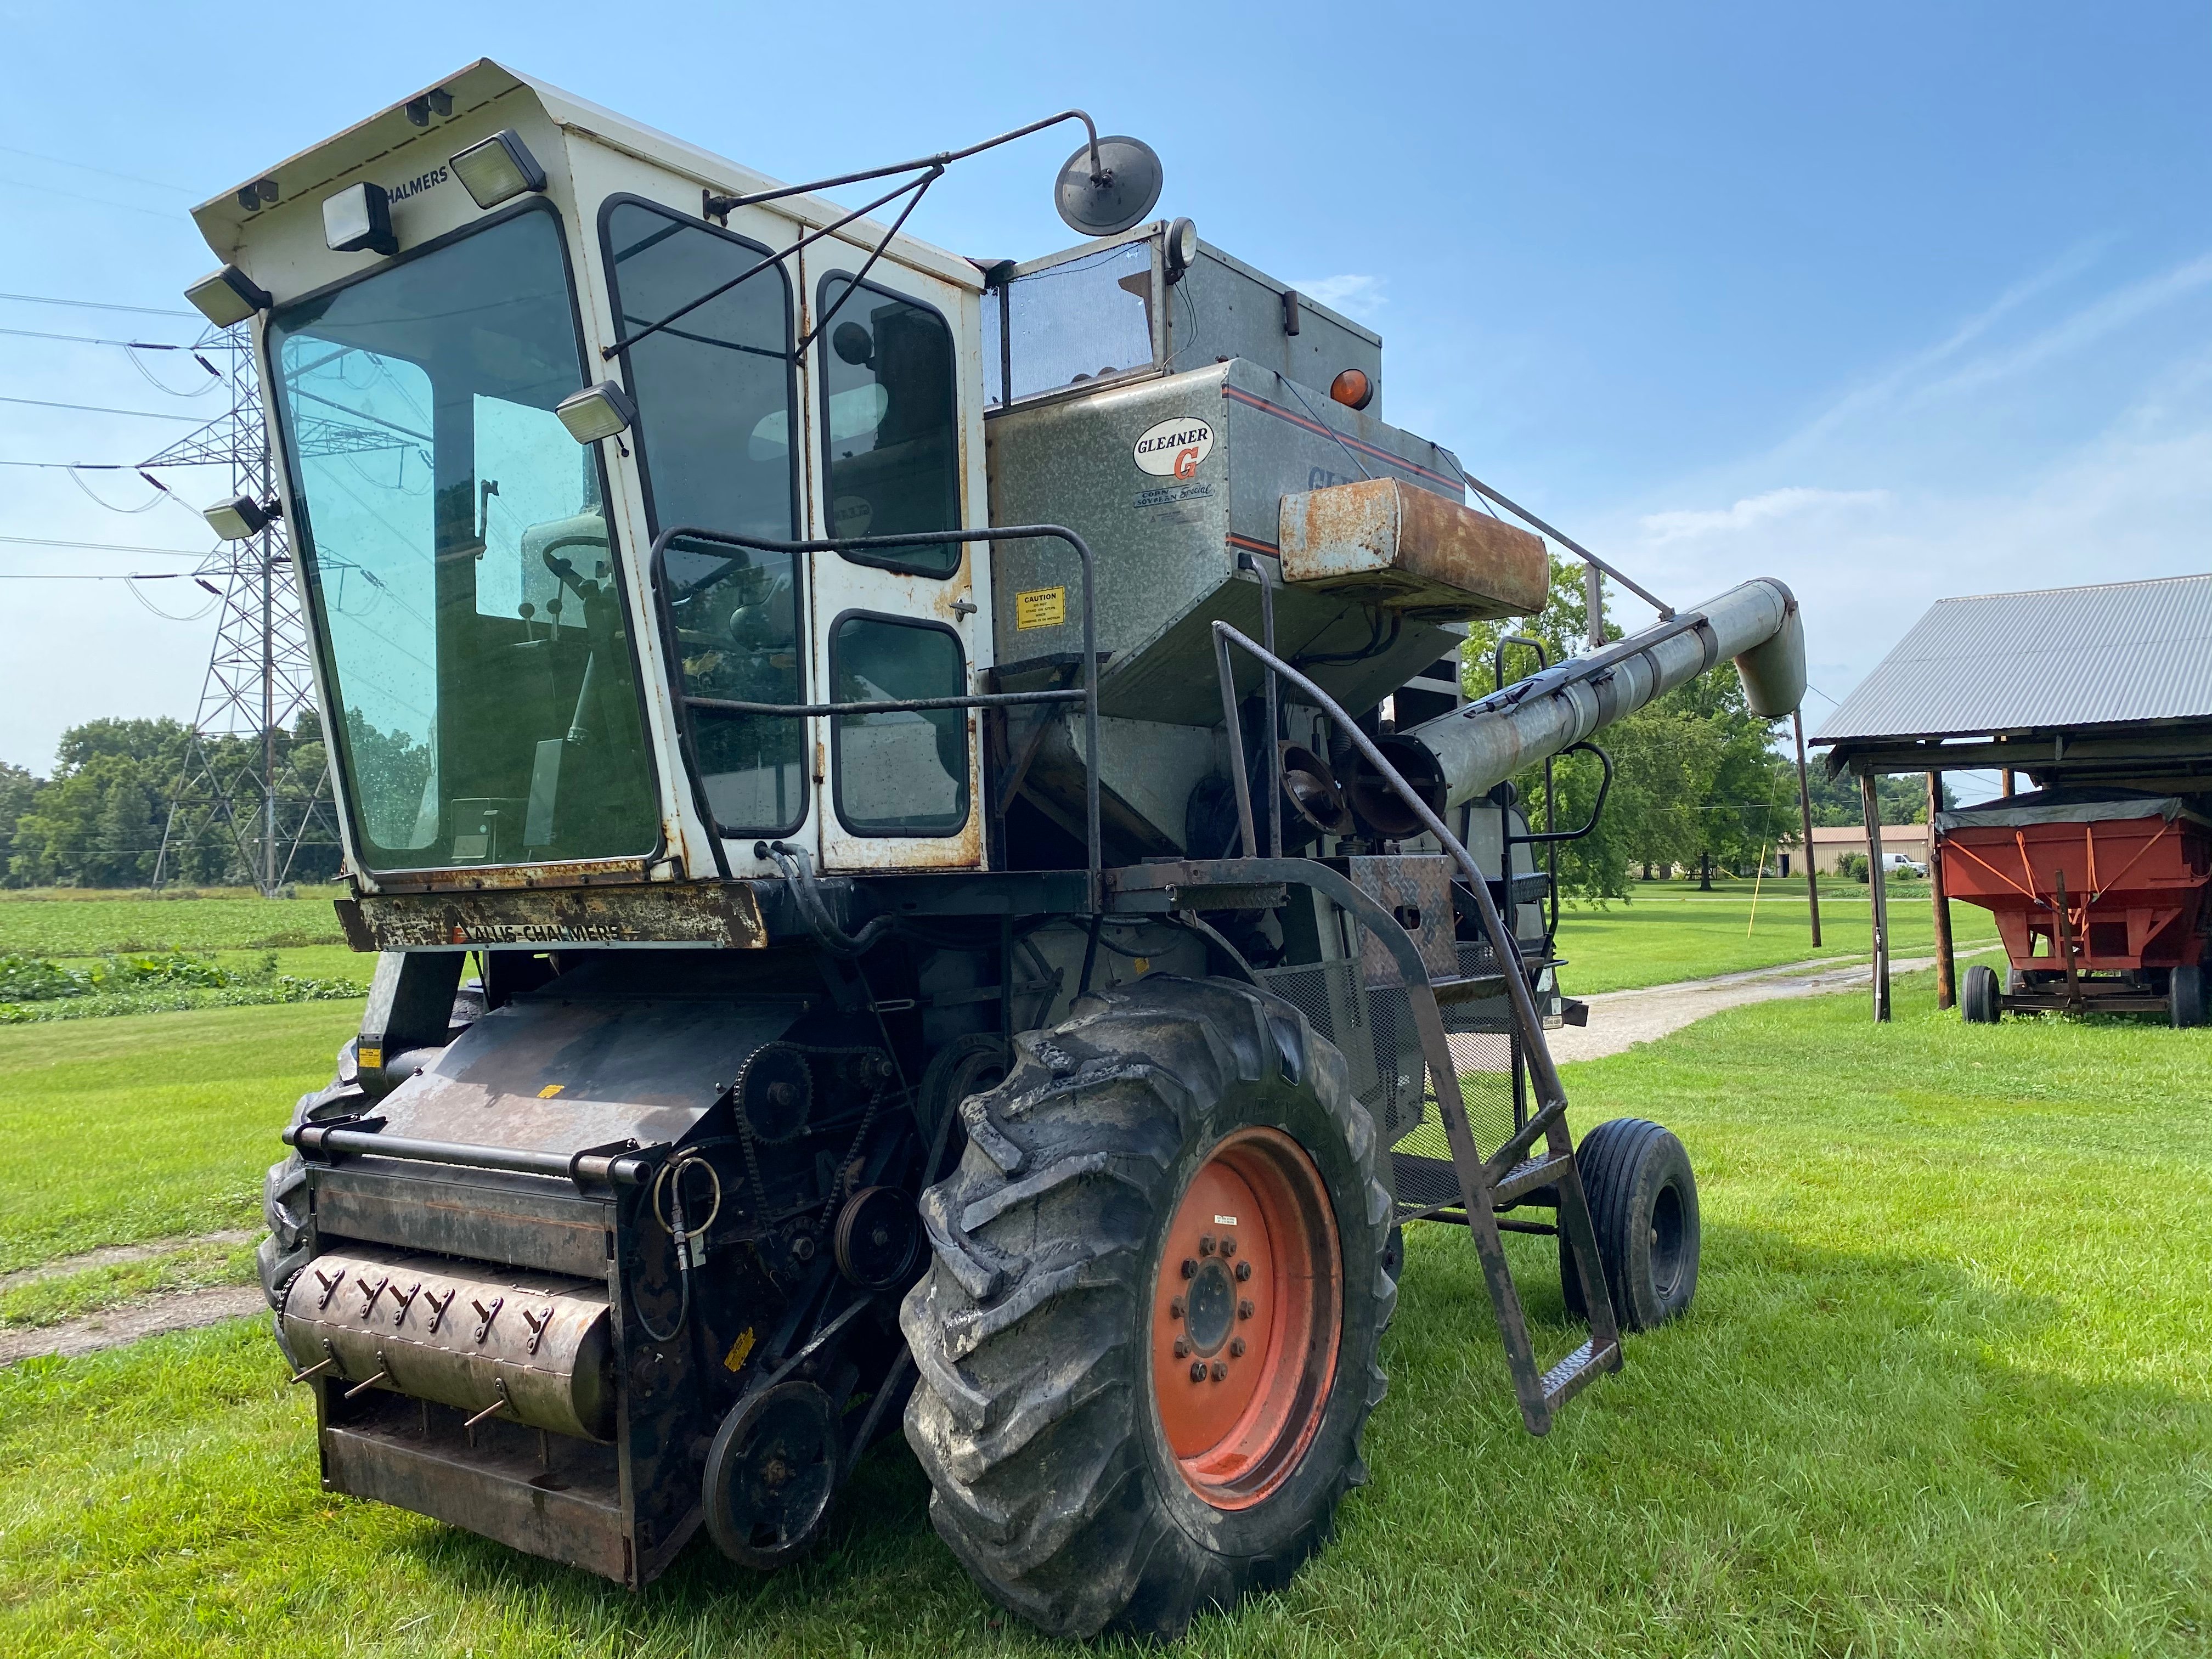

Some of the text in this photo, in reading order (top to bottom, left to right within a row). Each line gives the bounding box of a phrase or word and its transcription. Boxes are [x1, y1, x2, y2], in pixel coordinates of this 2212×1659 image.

[386, 166, 448, 204] HALMERS
[1138, 427, 1208, 454] GLEANER
[1173, 446, 1199, 480] G
[1024, 592, 1056, 603] CAUTION
